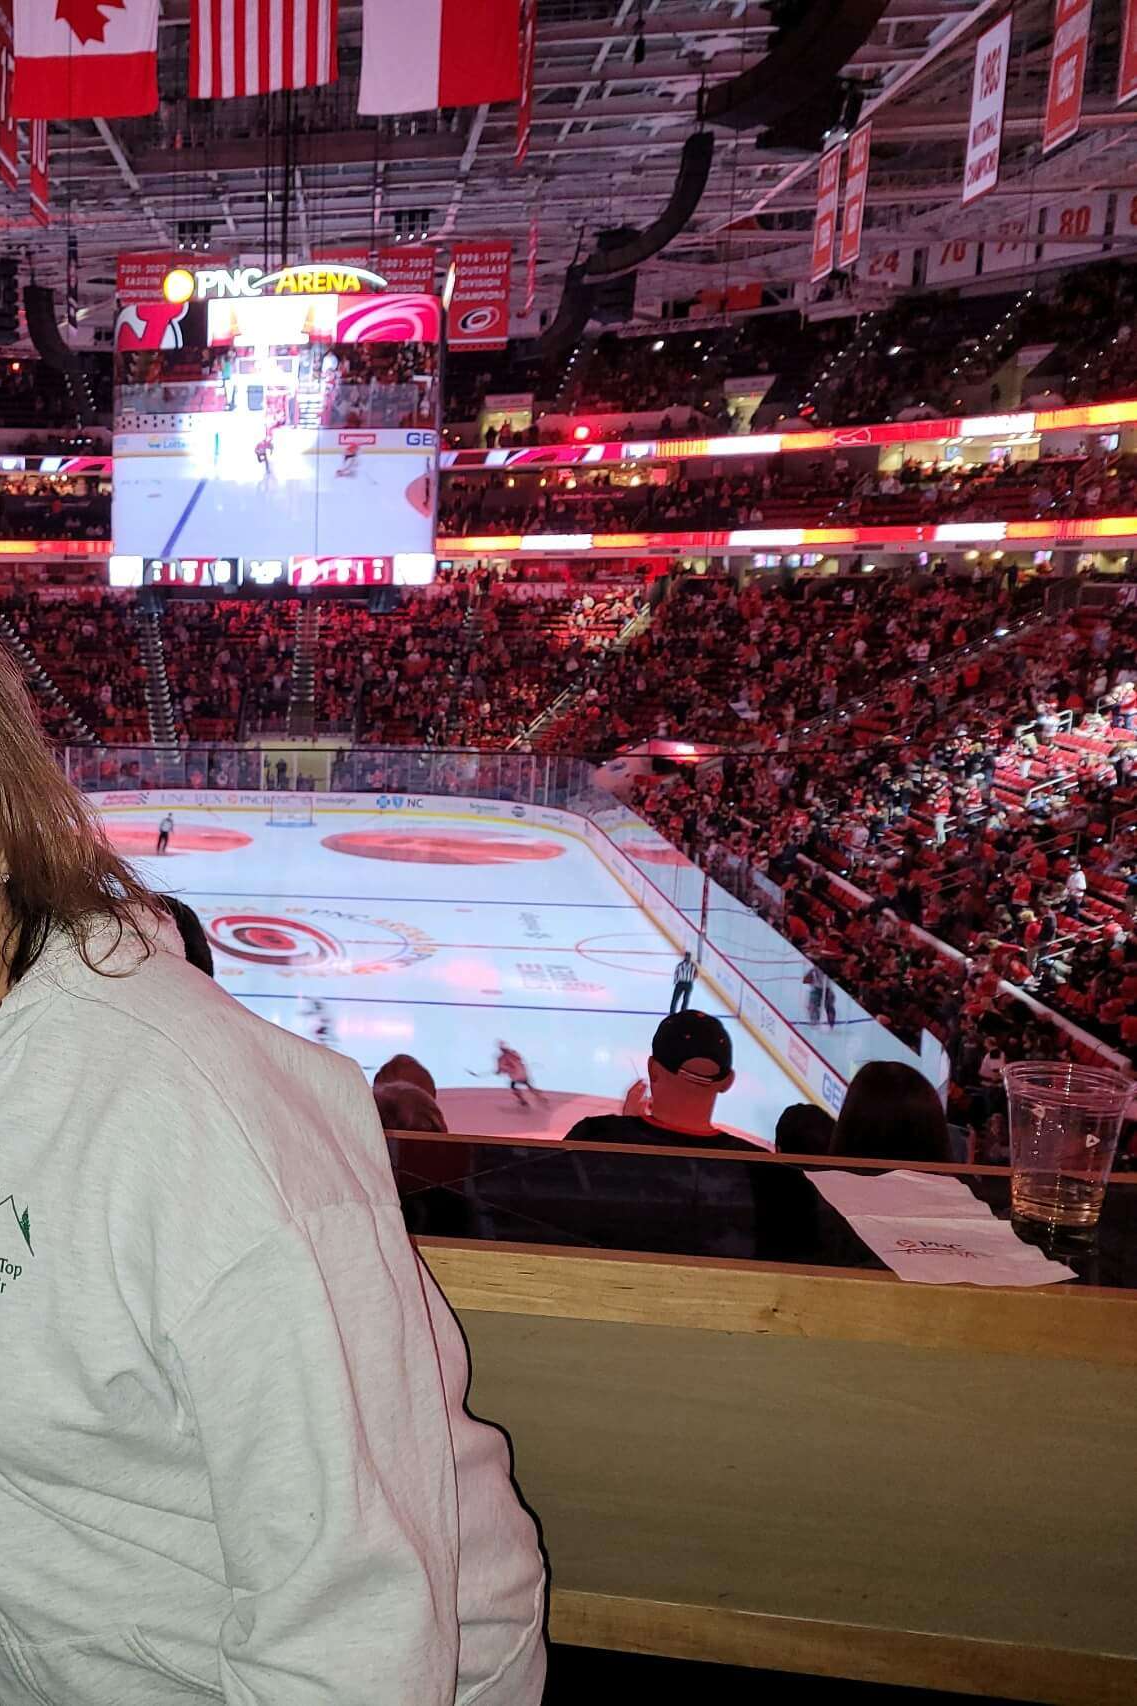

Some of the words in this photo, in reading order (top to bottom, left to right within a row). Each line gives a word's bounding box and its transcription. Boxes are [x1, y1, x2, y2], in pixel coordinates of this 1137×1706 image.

[1059, 206, 1091, 236] 80
[195, 268, 264, 298] PNC
[275, 268, 361, 294] ARENA
[407, 798, 424, 809] NC
